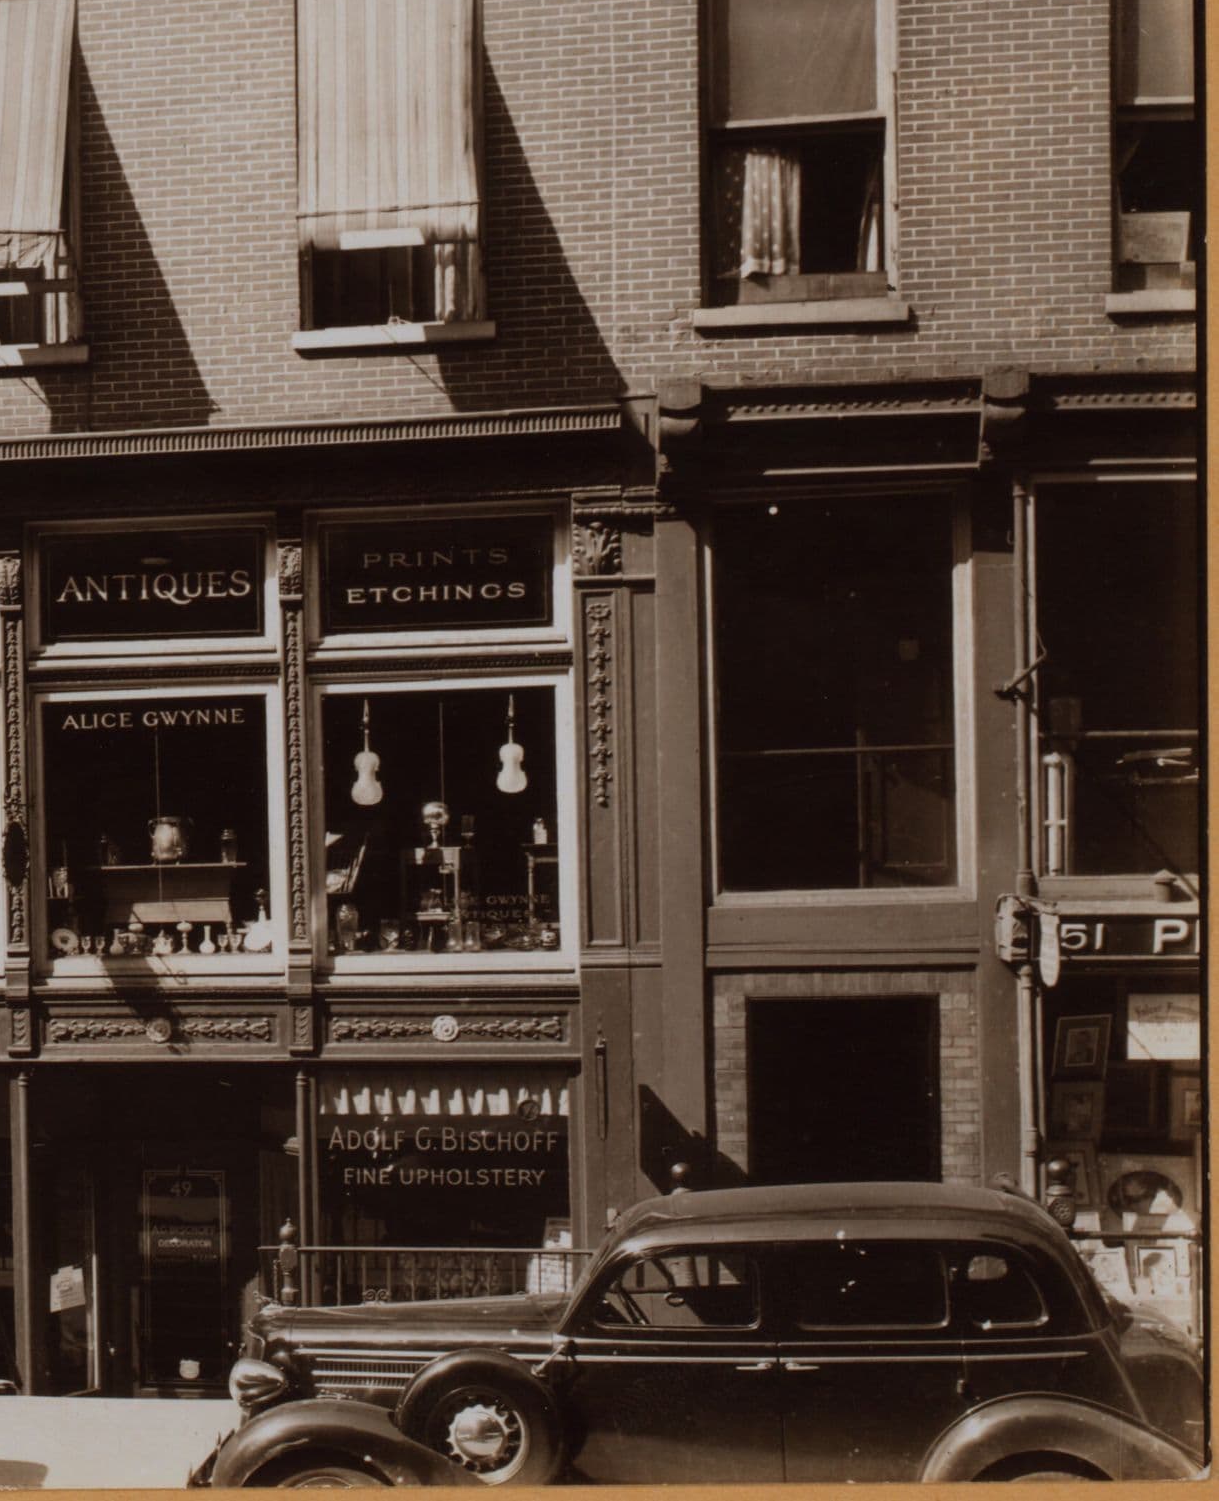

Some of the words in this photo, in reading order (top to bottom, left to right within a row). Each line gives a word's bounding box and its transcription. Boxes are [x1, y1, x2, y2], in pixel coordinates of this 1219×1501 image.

[362, 547, 509, 569] PRINTS
[55, 569, 252, 605] ANTIQUES
[346, 582, 527, 604] ETCHINGS
[61, 712, 134, 730] ALICE
[142, 708, 246, 727] GWYNNE
[1060, 923, 1104, 950] 51
[328, 1125, 406, 1152] ADOLF
[441, 1126, 559, 1153] BISCHOFF
[343, 1166, 392, 1185] FINE
[398, 1167, 547, 1186] UPHOLSTERY
